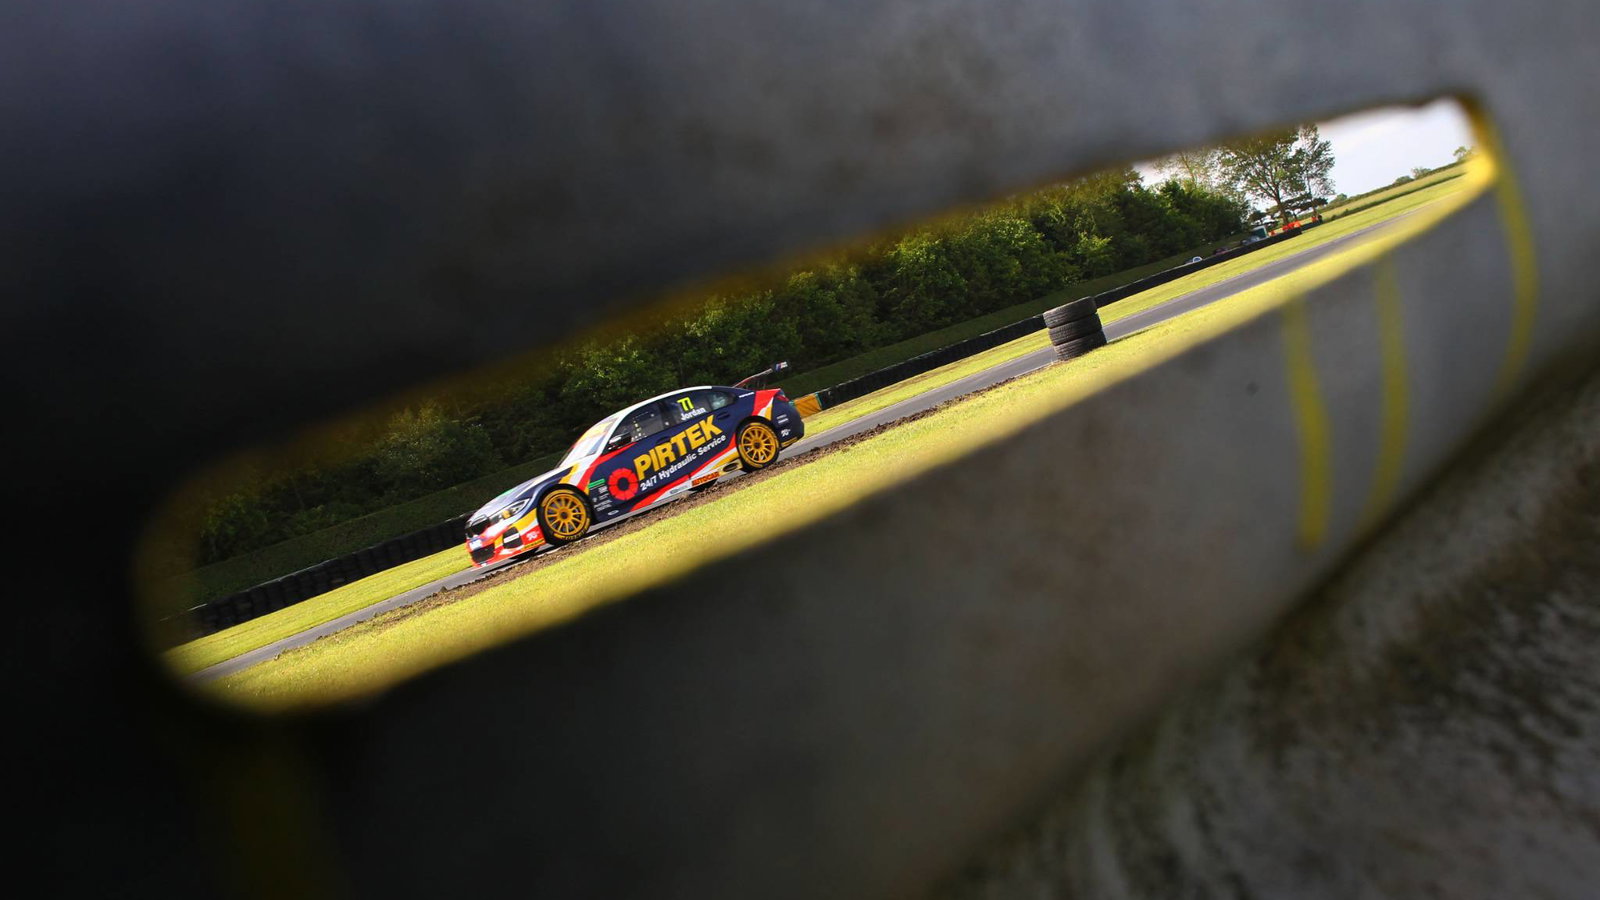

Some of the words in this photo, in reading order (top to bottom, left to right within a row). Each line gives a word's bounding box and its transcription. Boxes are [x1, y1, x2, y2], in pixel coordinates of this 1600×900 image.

[677, 396, 695, 411] 77
[681, 407, 706, 420] Jordan
[633, 414, 723, 481] PIRTEK
[640, 475, 657, 491] 24/7
[658, 453, 697, 480] Hydraulic
[697, 435, 726, 456] Service
